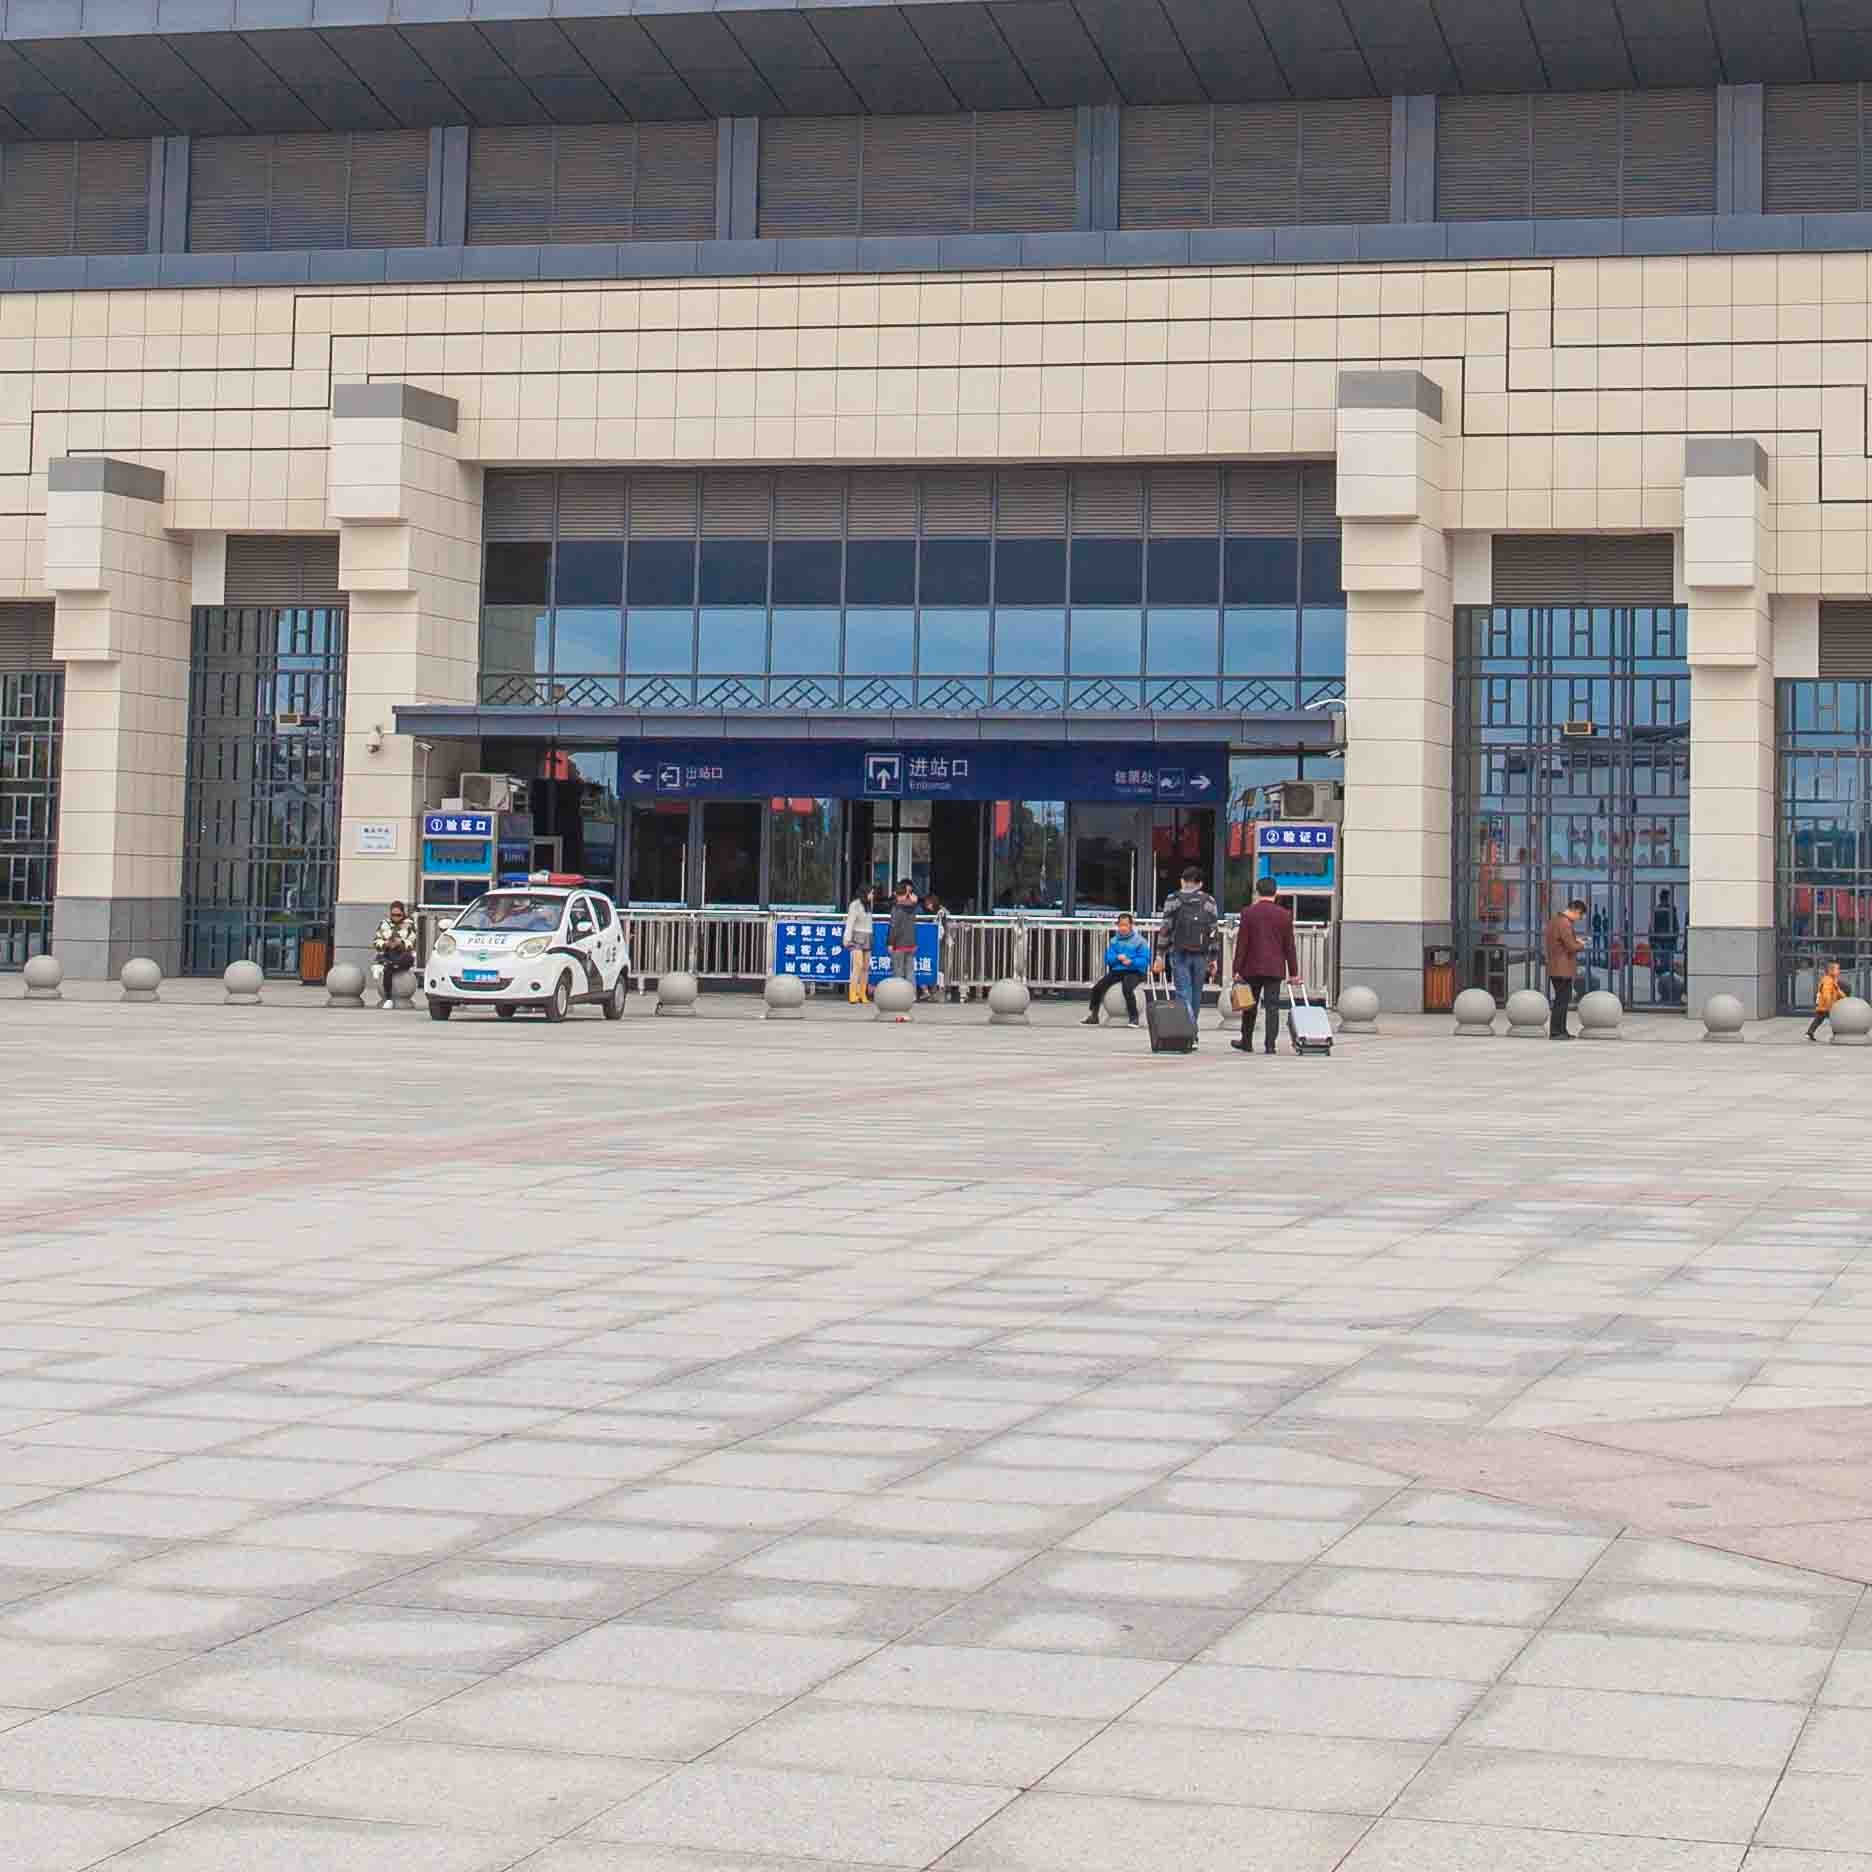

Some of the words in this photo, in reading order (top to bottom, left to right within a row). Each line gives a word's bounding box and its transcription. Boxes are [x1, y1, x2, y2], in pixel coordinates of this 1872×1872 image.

[685, 765, 723, 779] 出站口
[908, 756, 968, 777] 进站口
[467, 936, 507, 945] POLICE
